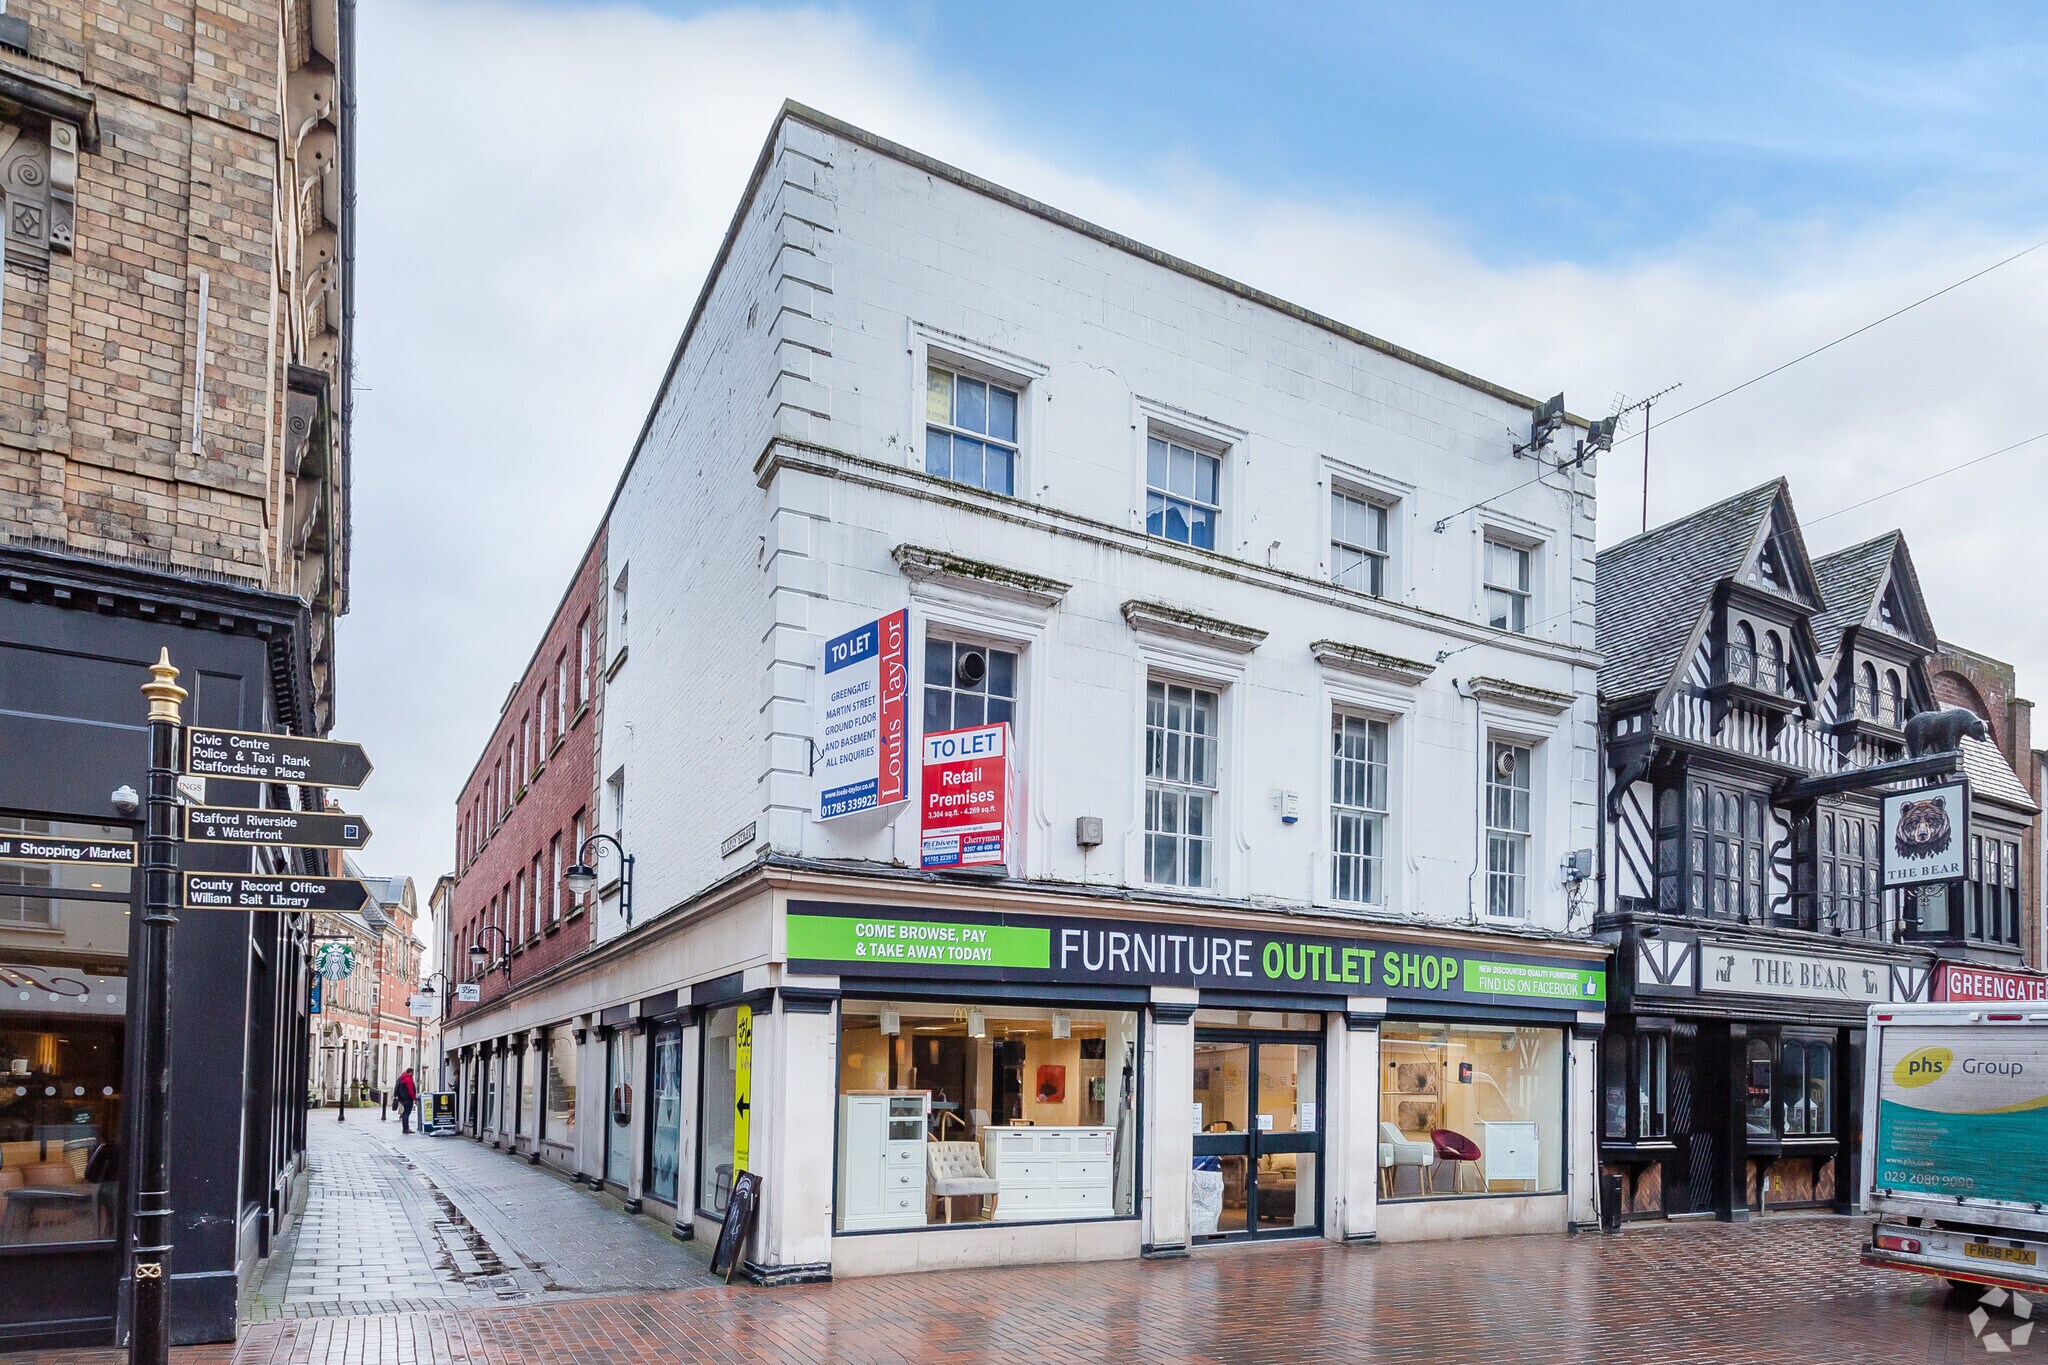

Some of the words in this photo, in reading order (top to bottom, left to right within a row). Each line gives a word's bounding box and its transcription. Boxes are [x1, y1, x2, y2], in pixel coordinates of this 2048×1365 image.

[831, 642, 847, 663] TO
[850, 632, 871, 657] LET
[882, 620, 908, 714] Taylor
[826, 703, 851, 720] MARTIN
[852, 695, 876, 712] STREET
[825, 719, 854, 736] GROUND
[854, 712, 877, 727] FLOOR
[193, 733, 222, 746] Civic
[230, 736, 270, 750] Centre
[825, 740, 840, 752] AND
[840, 729, 877, 748] BASEMENT
[931, 739, 956, 759] TO
[960, 733, 997, 755] LET
[192, 747, 228, 759] Police
[235, 751, 245, 761] &
[252, 752, 275, 764] Taxi
[282, 754, 311, 767] Rank
[826, 757, 838, 768] ALL
[839, 746, 875, 765] ENQUIRIES
[882, 718, 901, 799] Louis
[192, 760, 267, 775] Staffordshire
[275, 766, 305, 779] Place
[942, 766, 982, 786] Retail
[822, 798, 846, 817] 01785
[847, 793, 877, 812] 339922
[929, 789, 995, 808] Premises
[191, 812, 239, 825] Stafford
[247, 815, 298, 828] Riverside
[206, 827, 216, 837] &
[222, 827, 283, 840] Waterfront
[963, 835, 1000, 844] Cherryman
[20, 842, 132, 859] Shopping/Market
[1887, 868, 1917, 880] THE
[1922, 863, 1960, 876] BEAR
[190, 878, 233, 892] County
[241, 880, 283, 892] Record
[290, 882, 326, 894] Office
[191, 892, 232, 904] William
[239, 893, 263, 905] Salt
[270, 894, 309, 908] Library
[855, 923, 896, 939] COME
[899, 925, 959, 944] BROWSE,
[962, 929, 987, 943] PAY
[855, 942, 866, 956] &
[870, 943, 904, 958] TAKE
[907, 945, 945, 959] AWAY
[947, 946, 992, 961] TODAY!
[1060, 929, 1253, 977] FURNITURE
[1262, 941, 1376, 984] OUTLET
[1382, 951, 1459, 990] SHOP
[1479, 965, 1492, 973] NEW
[1493, 966, 1526, 976] DISCOUNTED
[1528, 969, 1549, 978] QUALITY
[1549, 971, 1578, 980] FURNITURE
[1752, 958, 1794, 986] THE
[1800, 963, 1847, 990] BEAR
[1479, 977, 1501, 990] FIND
[1503, 979, 1516, 992] US
[1517, 980, 1531, 993] ON
[1533, 981, 1578, 996] FACEBOOK
[1950, 971, 2044, 1000] GREENGATE
[1909, 1056, 1943, 1075] phs
[1962, 1058, 2023, 1078] Group
[1884, 1170, 1907, 1182] 029
[1909, 1172, 1940, 1185] 2080
[1942, 1175, 1974, 1189] 9090
